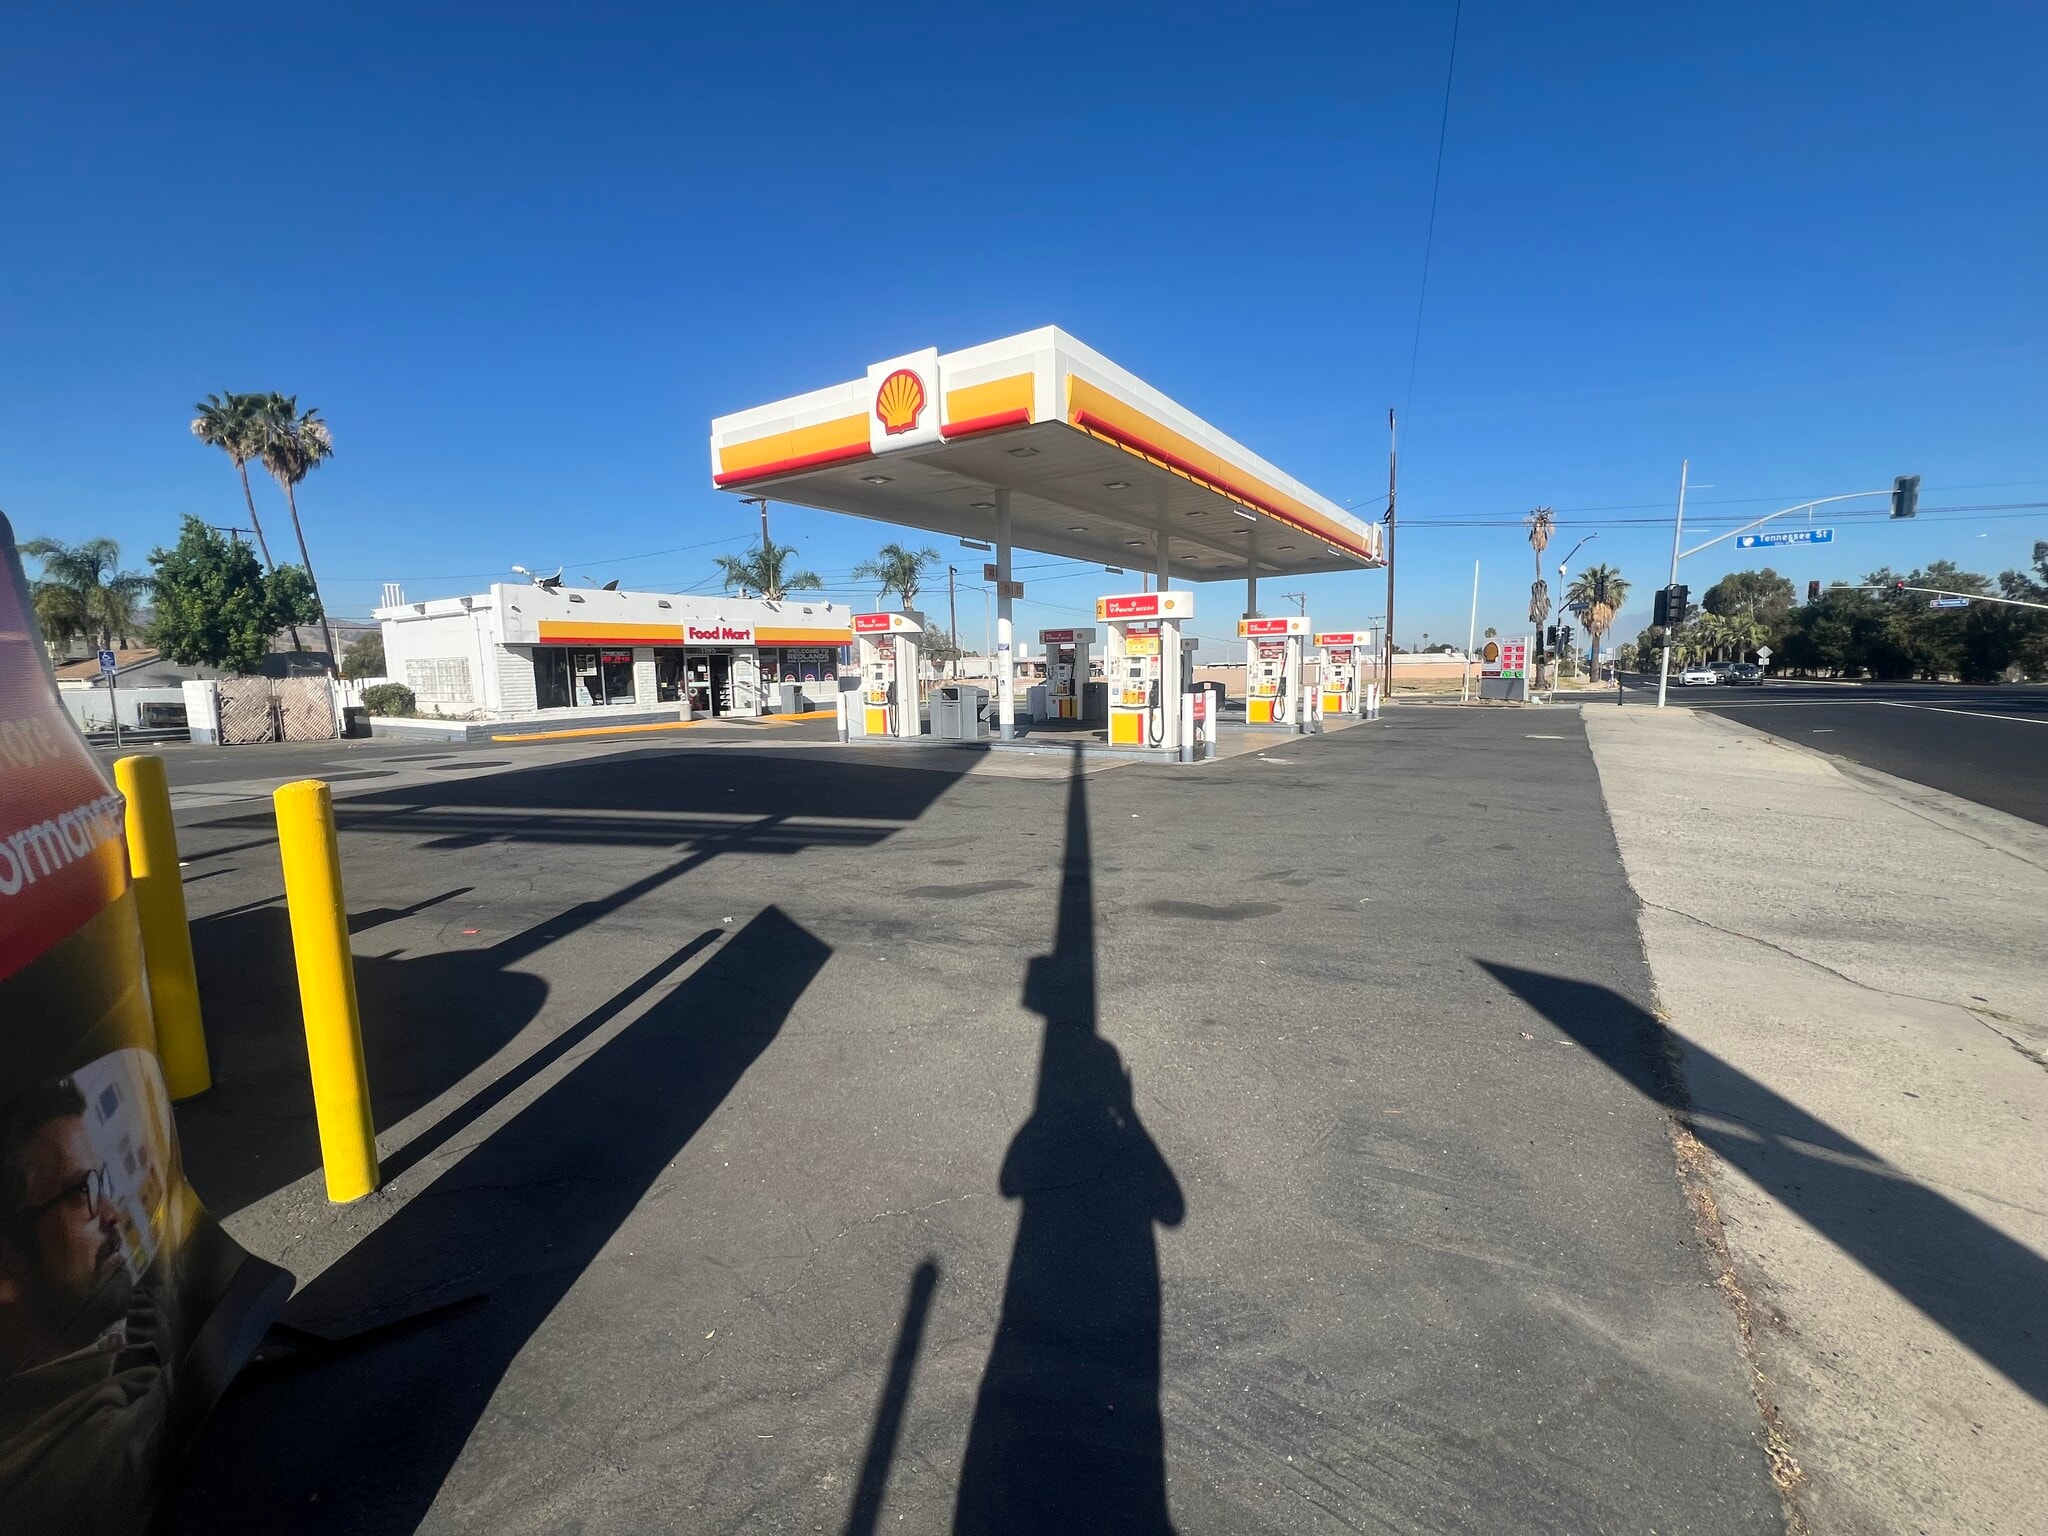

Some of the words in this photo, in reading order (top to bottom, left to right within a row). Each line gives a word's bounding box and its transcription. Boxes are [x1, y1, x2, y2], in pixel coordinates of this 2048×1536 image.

[1760, 533, 1811, 542] Tennessee
[1816, 530, 1828, 539] St
[689, 626, 720, 640] Food
[722, 627, 751, 640] Mart
